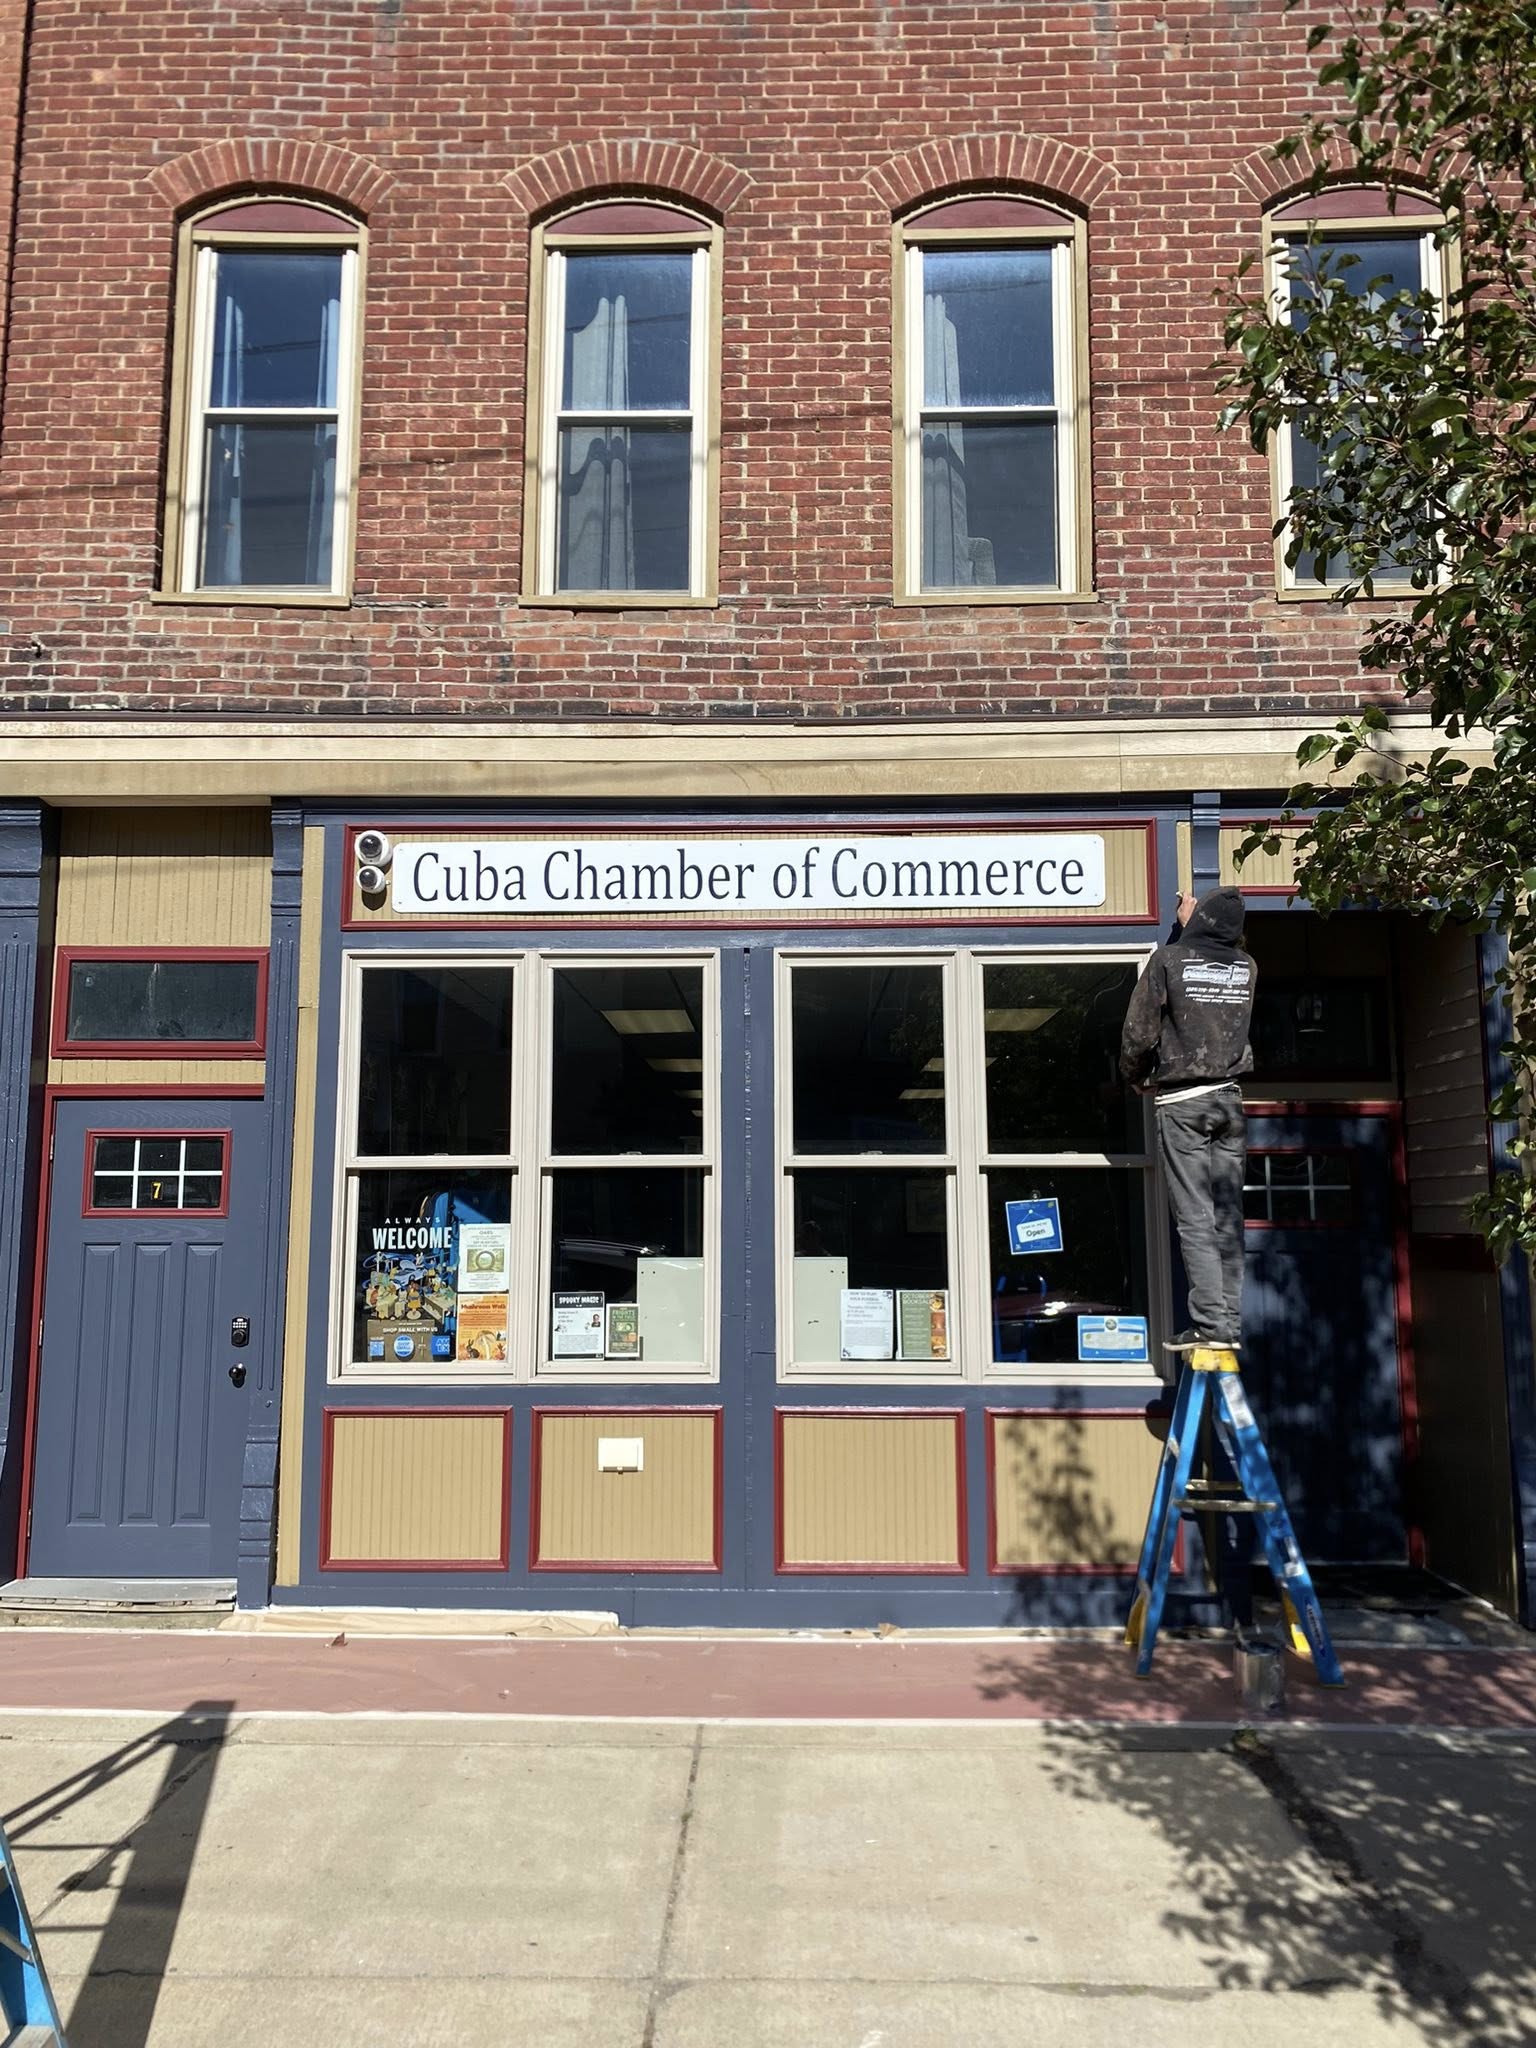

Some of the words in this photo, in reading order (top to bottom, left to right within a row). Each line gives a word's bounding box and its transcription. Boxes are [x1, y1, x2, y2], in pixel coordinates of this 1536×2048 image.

[413, 850, 527, 902] Cuba
[543, 848, 755, 901] Chamber
[773, 846, 820, 899] of
[831, 847, 1085, 898] Commerce
[153, 1182, 162, 1199] 7
[385, 1216, 441, 1225] ALWAYS
[372, 1226, 453, 1250] WELCOME
[1026, 1229, 1046, 1237] Open
